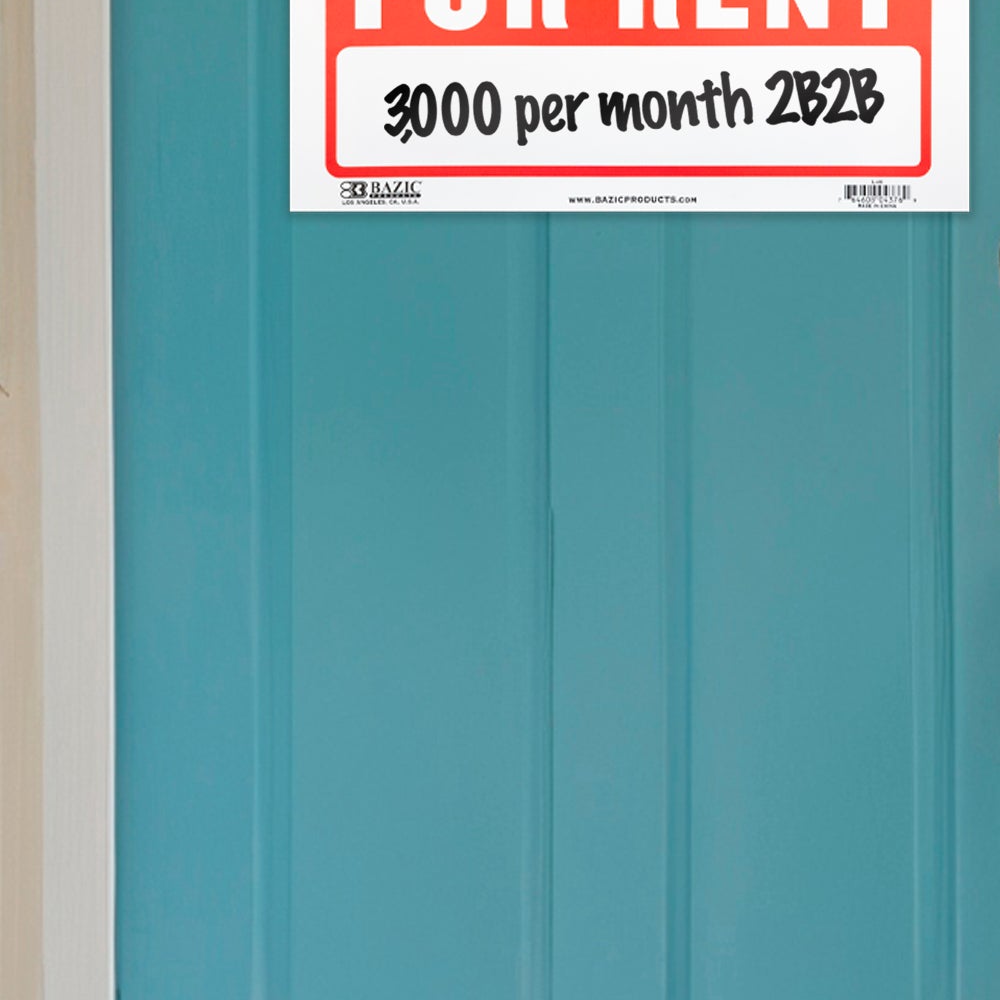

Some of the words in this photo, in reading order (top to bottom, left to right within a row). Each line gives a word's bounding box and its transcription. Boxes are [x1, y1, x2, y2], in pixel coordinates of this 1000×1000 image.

[515, 92, 589, 146] per
[598, 72, 753, 131] month
[765, 68, 884, 126] 2B2B
[371, 180, 422, 194] BAZIC
